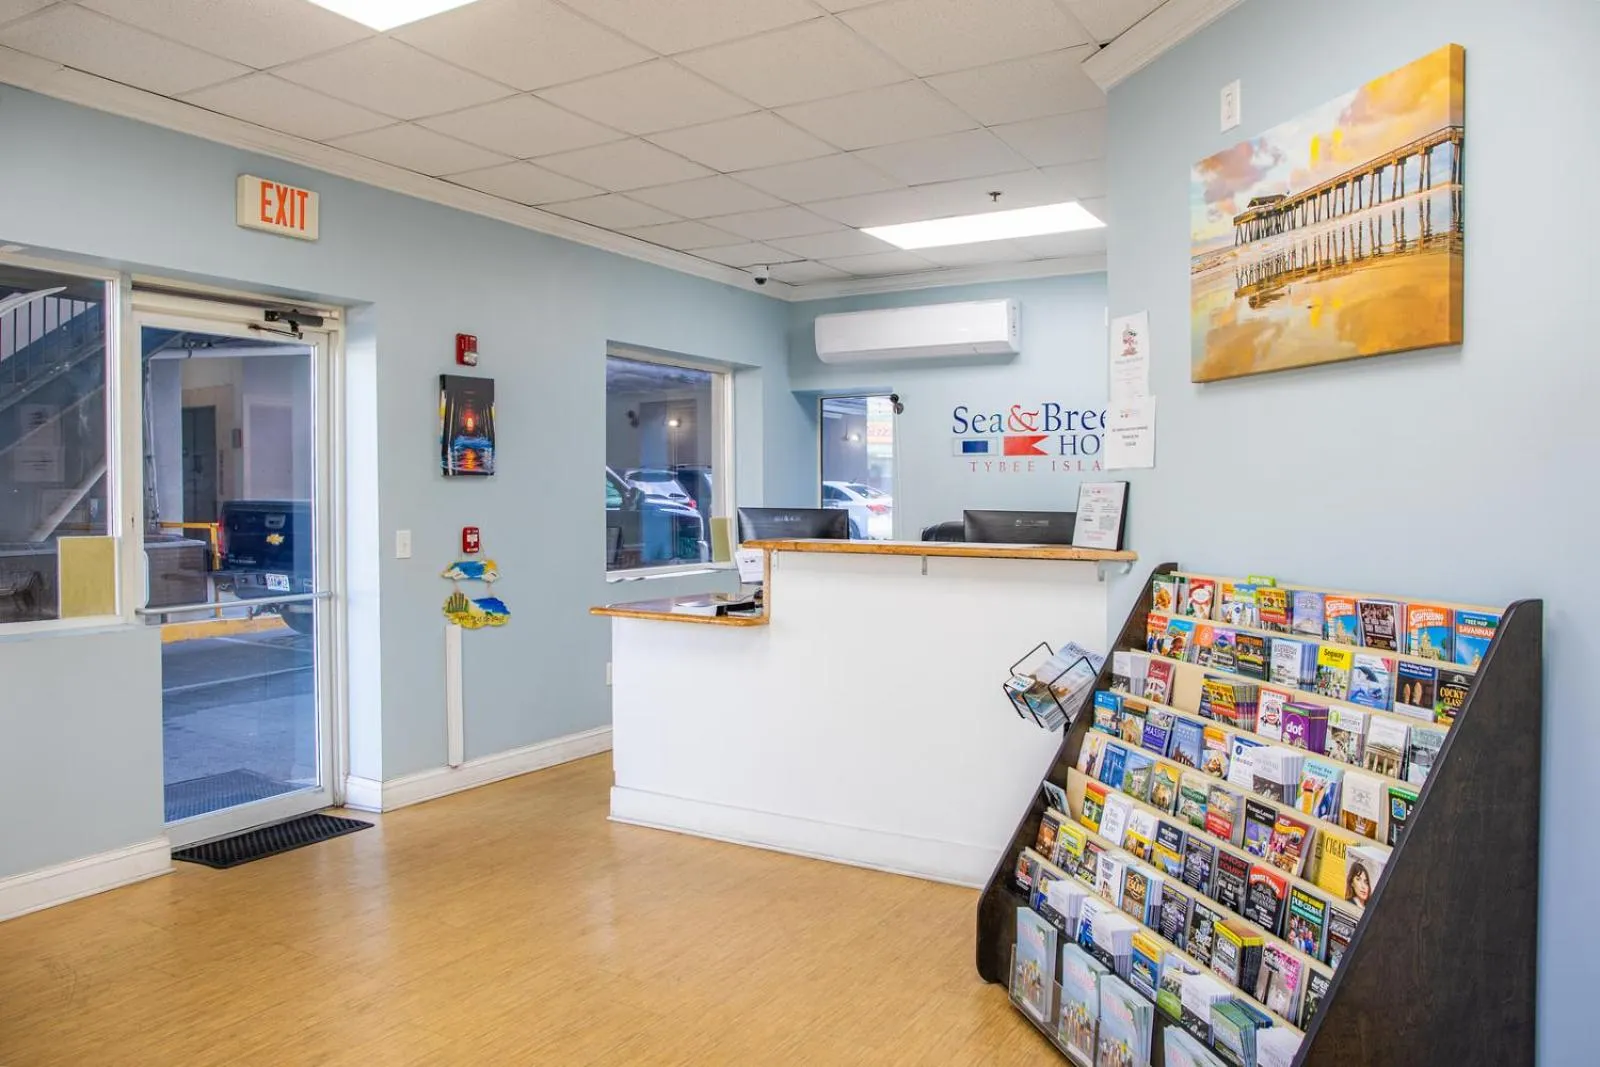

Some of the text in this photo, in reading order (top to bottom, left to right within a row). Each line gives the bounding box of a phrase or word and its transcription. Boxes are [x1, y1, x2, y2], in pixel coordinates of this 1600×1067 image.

[260, 181, 308, 231] EXIT
[1059, 433, 1105, 456] HO
[969, 460, 1037, 473] TYBEE
[1459, 625, 1495, 637] SAVANNAH
[1323, 648, 1345, 660] Segway
[1286, 721, 1304, 736] dot
[1325, 837, 1347, 861] CIGAR
